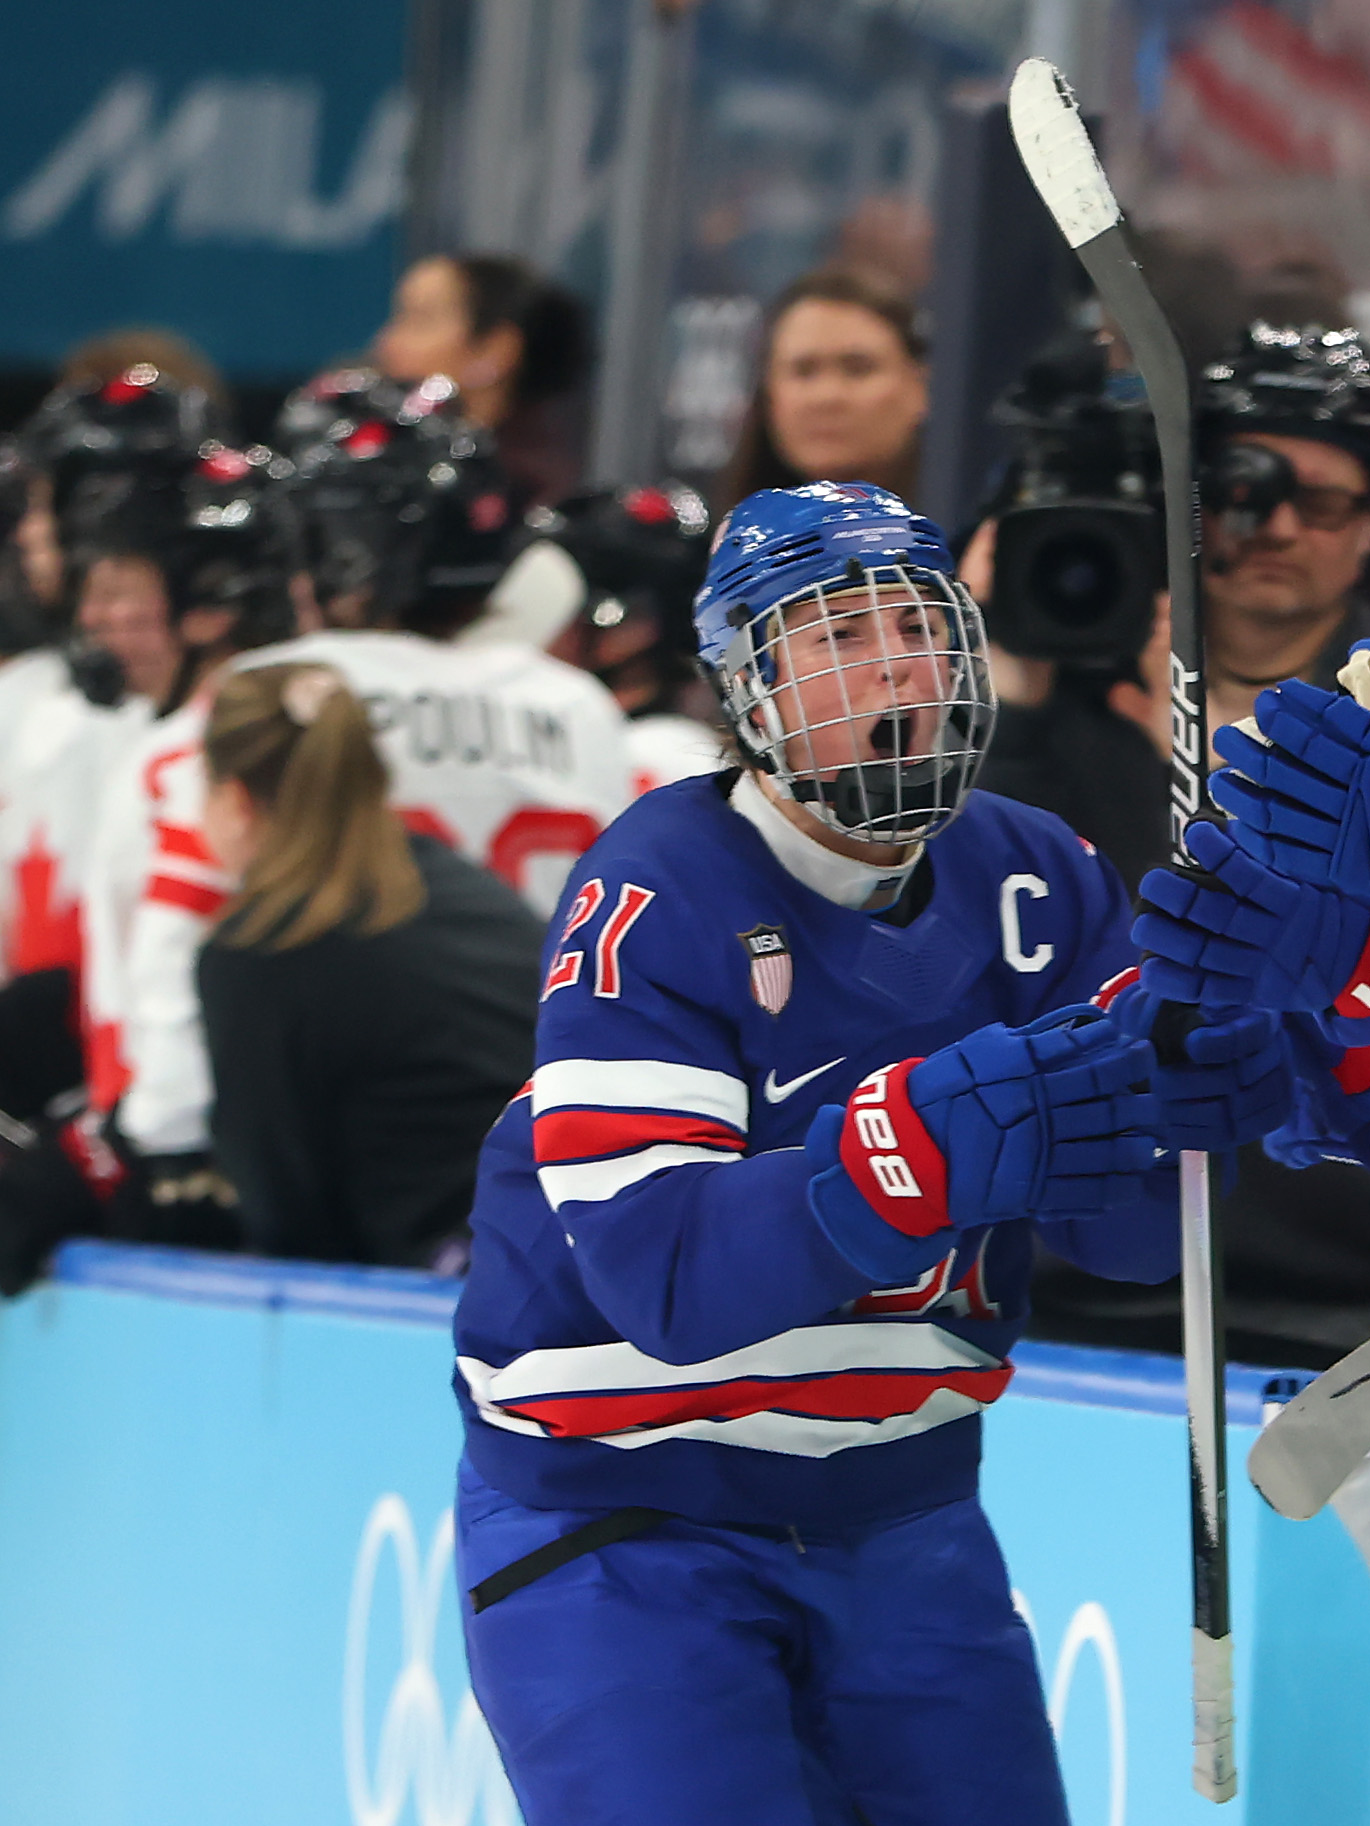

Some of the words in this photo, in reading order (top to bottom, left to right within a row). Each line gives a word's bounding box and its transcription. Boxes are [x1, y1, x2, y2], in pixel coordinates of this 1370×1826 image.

[1168, 650, 1201, 868] AUER
[538, 877, 657, 1004] 21
[1000, 873, 1055, 973] C
[853, 1061, 925, 1199] BAU
